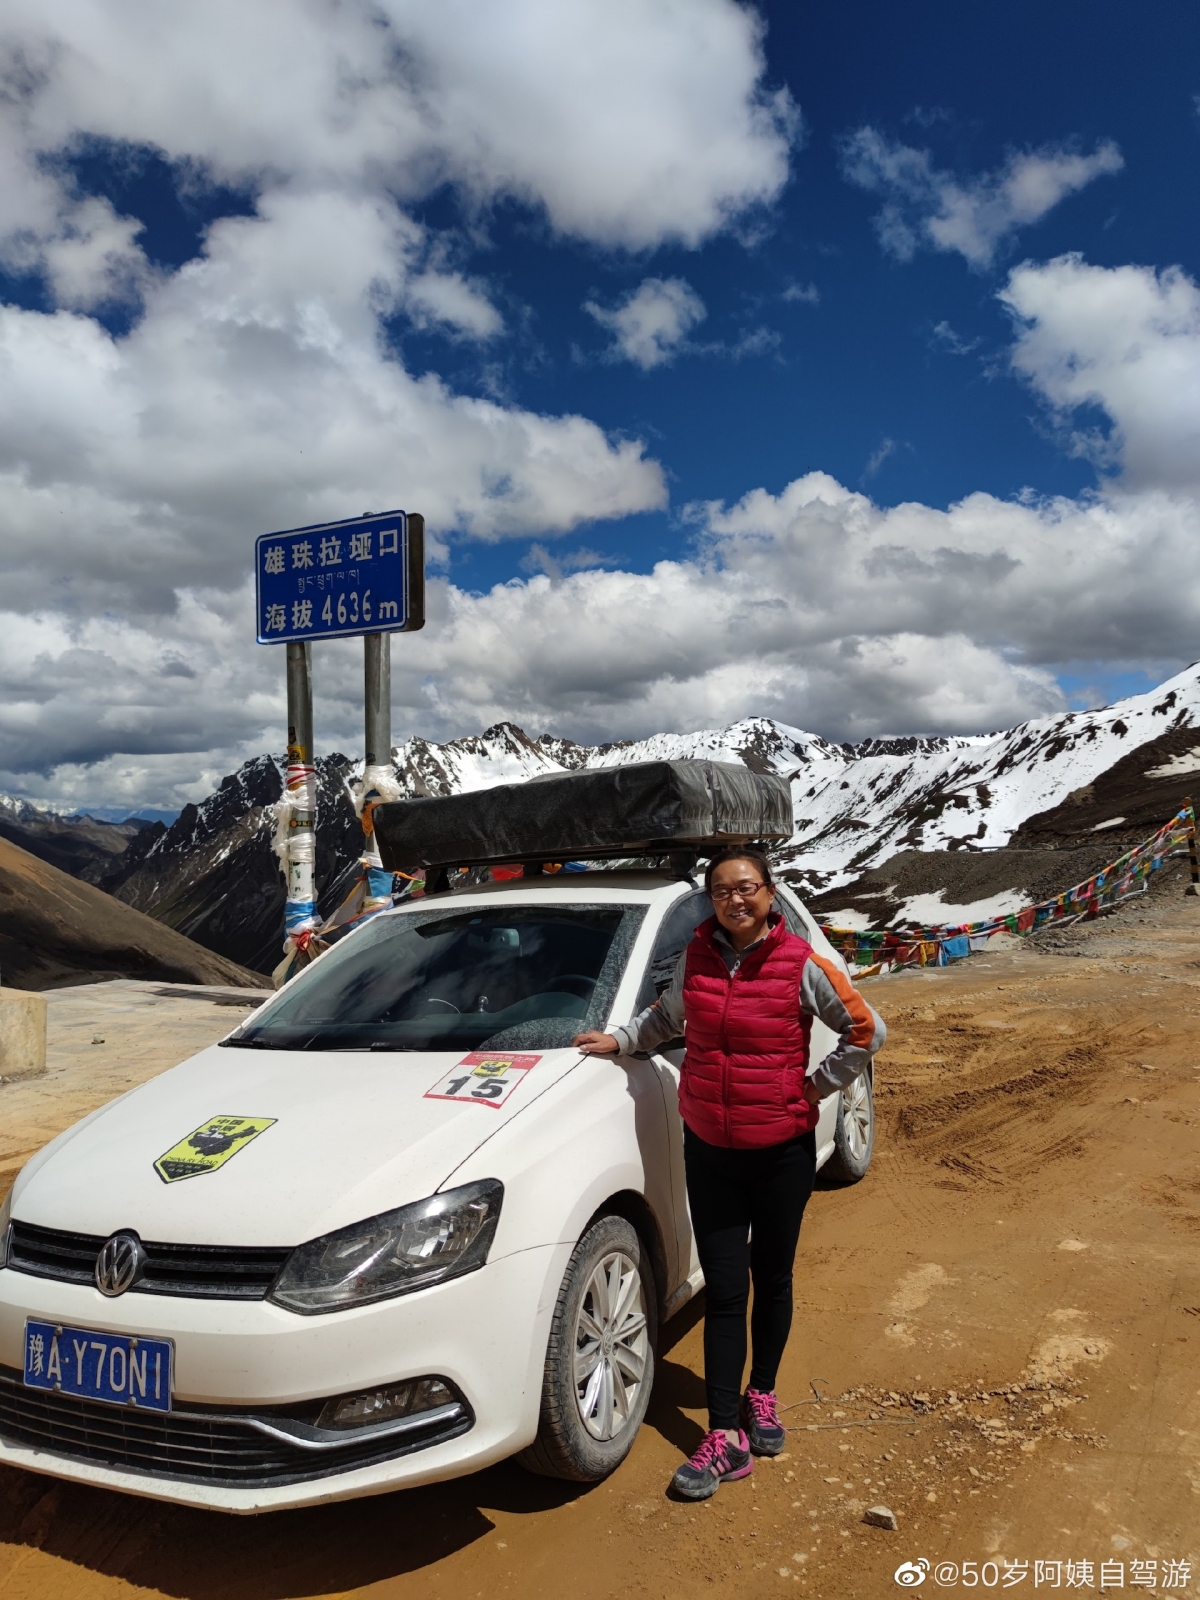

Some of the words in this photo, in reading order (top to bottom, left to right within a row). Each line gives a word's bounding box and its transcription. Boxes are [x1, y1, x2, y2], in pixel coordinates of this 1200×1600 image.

[264, 529, 398, 575] 雄珠拉垭口
[444, 1076, 509, 1099] 15
